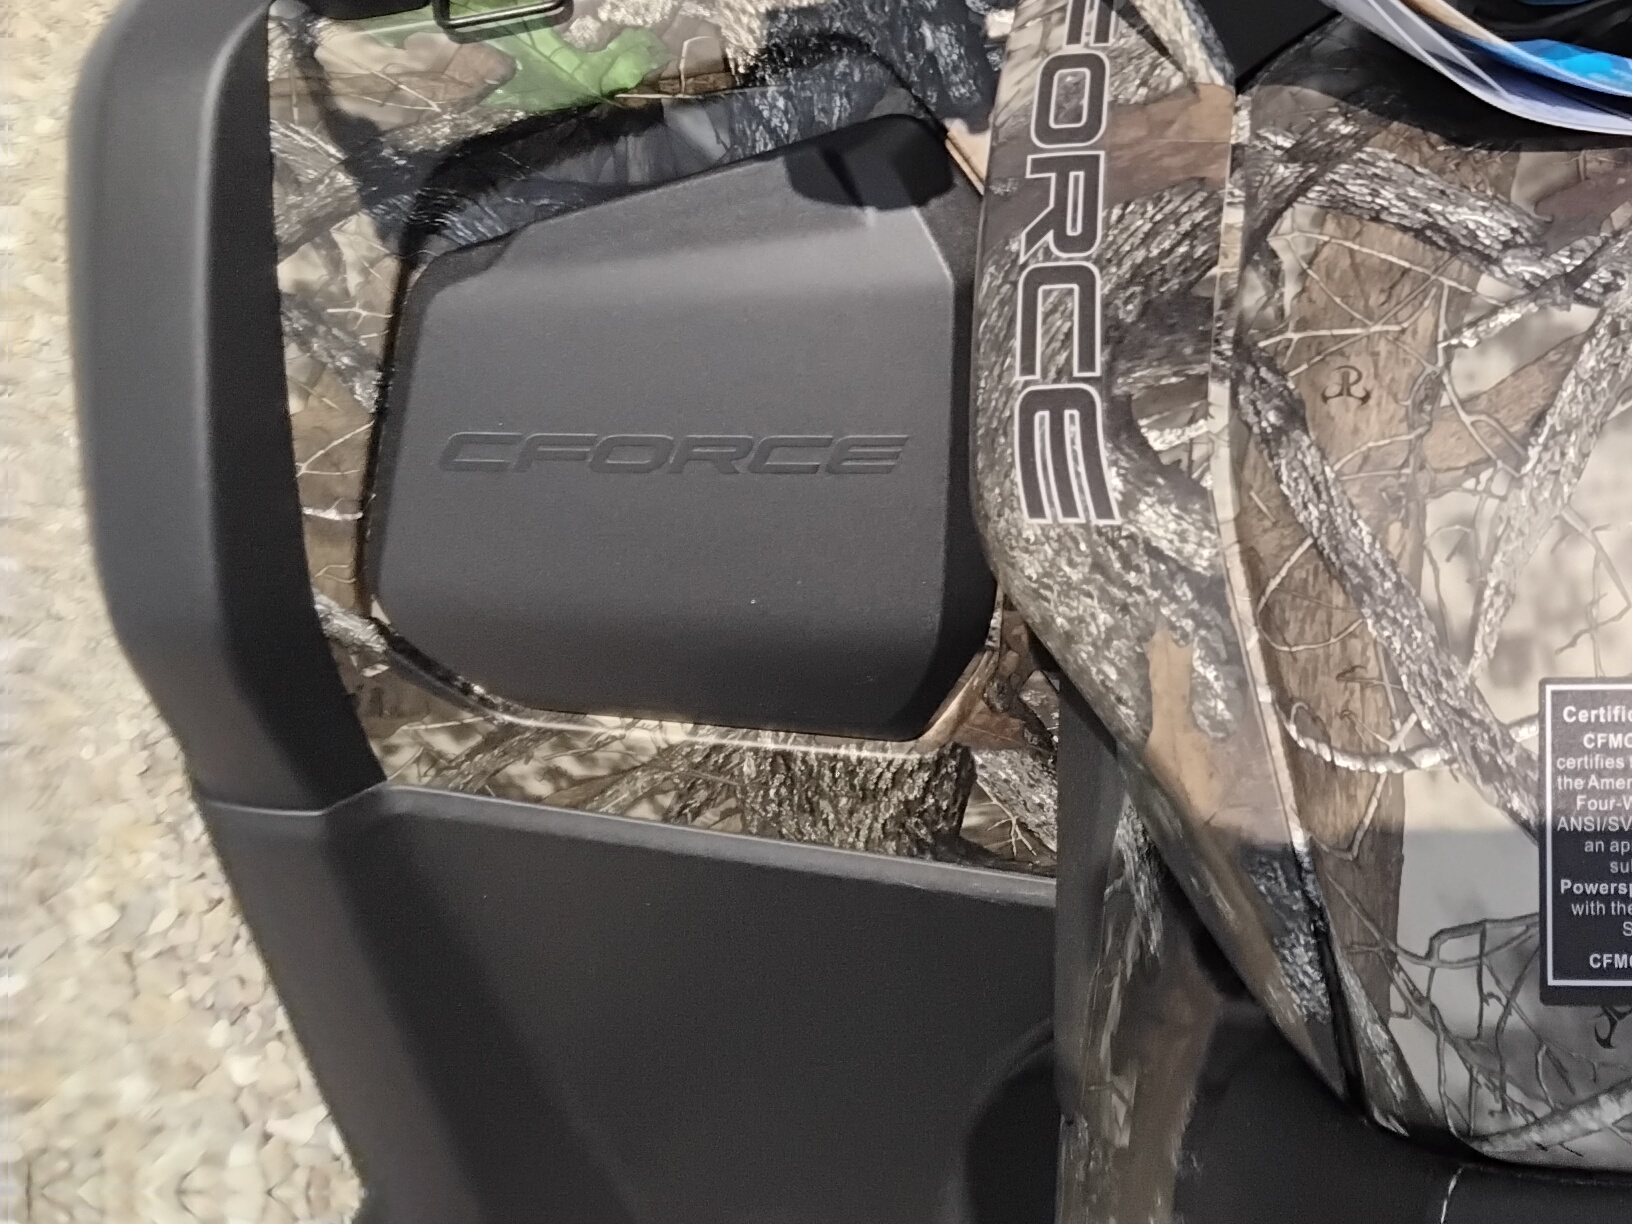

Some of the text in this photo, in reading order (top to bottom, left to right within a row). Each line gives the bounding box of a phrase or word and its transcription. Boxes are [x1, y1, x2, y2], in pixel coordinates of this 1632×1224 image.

[438, 431, 910, 476] CFORCE
[1557, 754, 1625, 770] certifies
[1557, 775, 1584, 790] the
[1585, 841, 1605, 853] an
[1571, 901, 1606, 916] with
